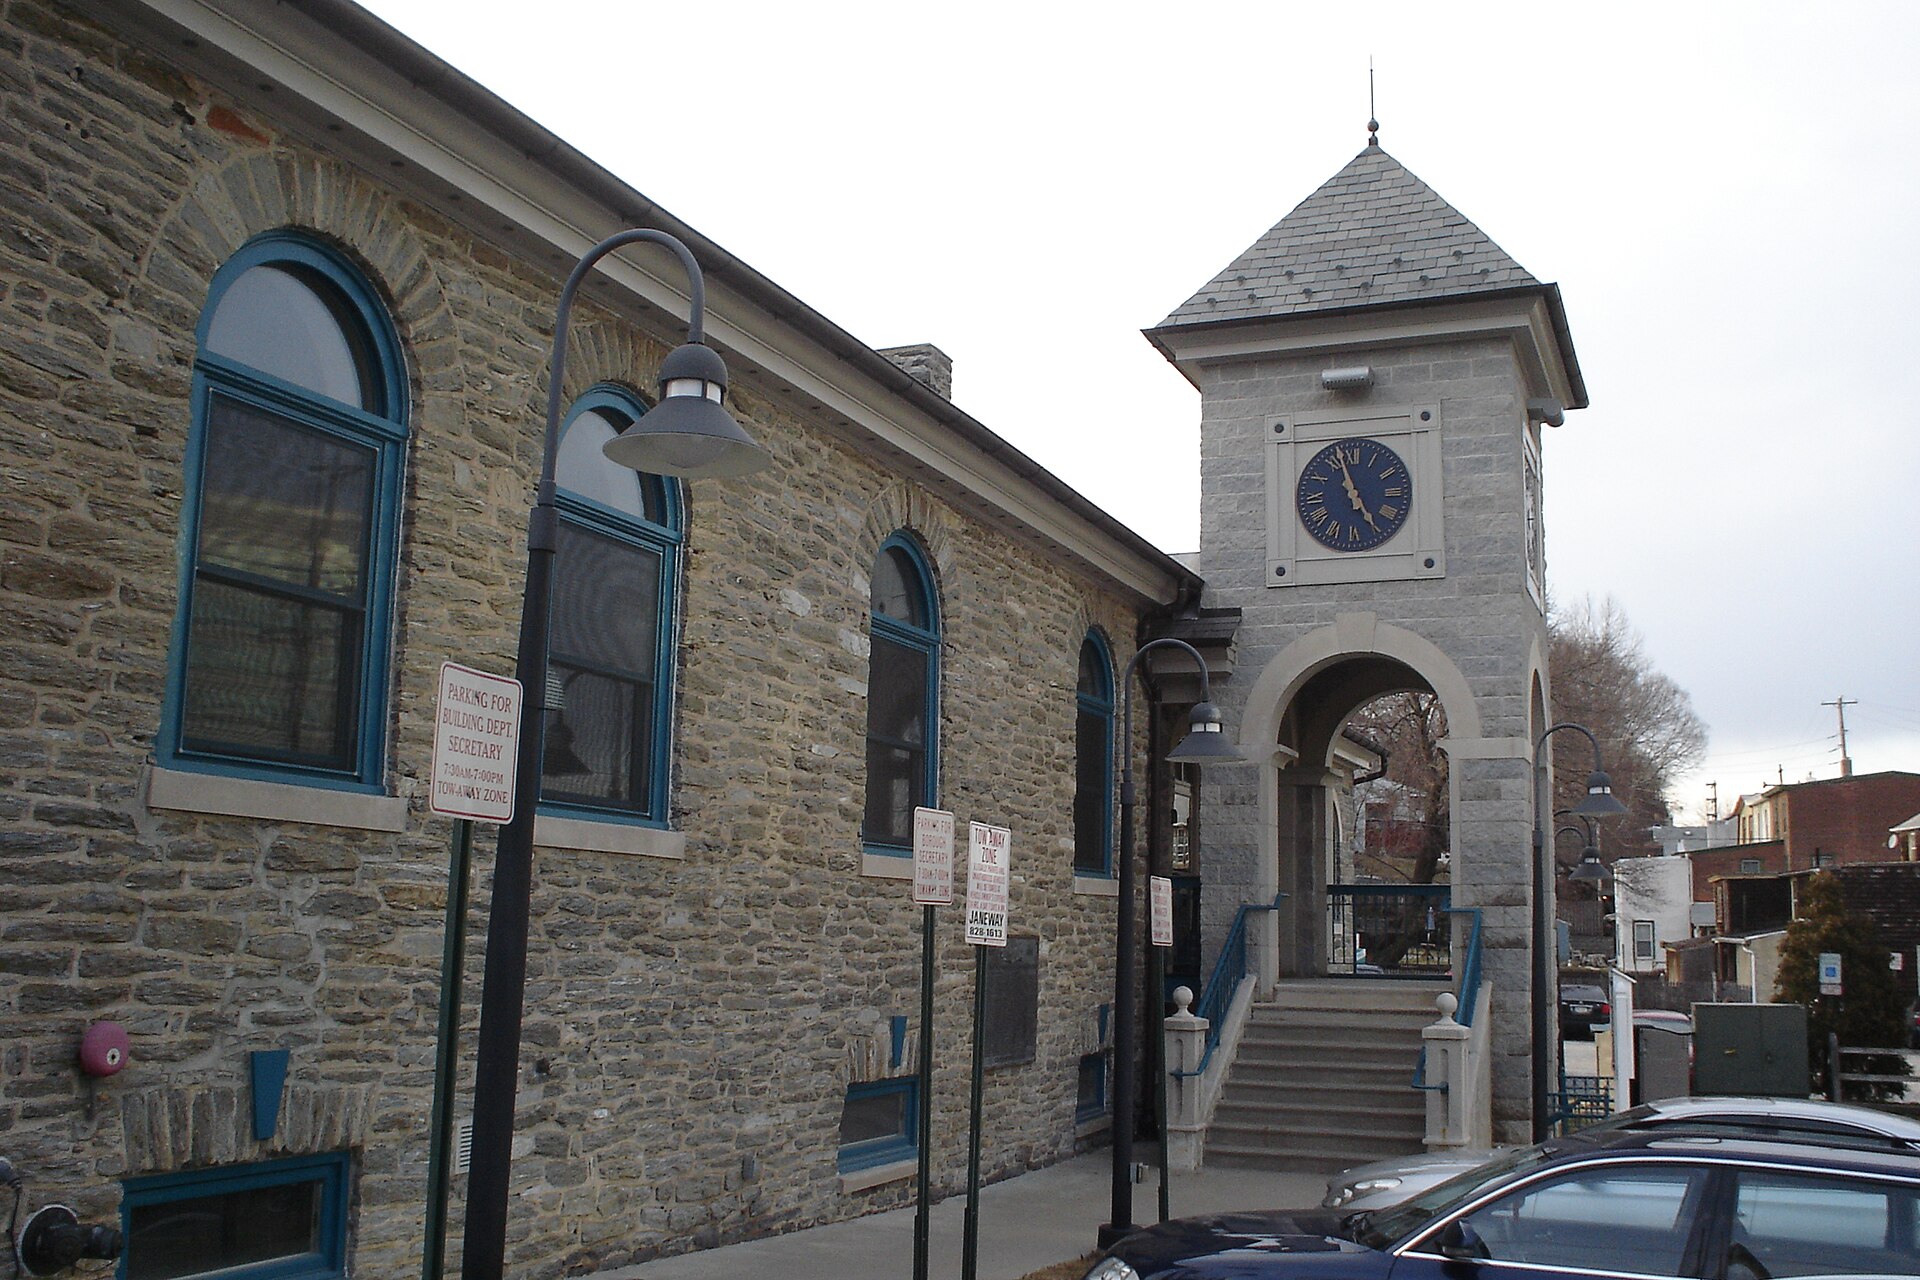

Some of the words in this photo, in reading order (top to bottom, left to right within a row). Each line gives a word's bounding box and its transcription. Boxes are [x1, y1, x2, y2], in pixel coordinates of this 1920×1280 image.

[448, 683, 488, 708] PARKING
[491, 696, 512, 712] FOR
[443, 708, 483, 732] BUILDING
[487, 720, 512, 738] DEPT.
[448, 735, 503, 760] SECRETARY
[438, 781, 481, 800] TOW-AWAY
[484, 789, 508, 803] ZONE
[982, 847, 997, 864] ZONE
[969, 911, 1004, 926] JANEWAY
[969, 927, 1002, 938] 828-1613
